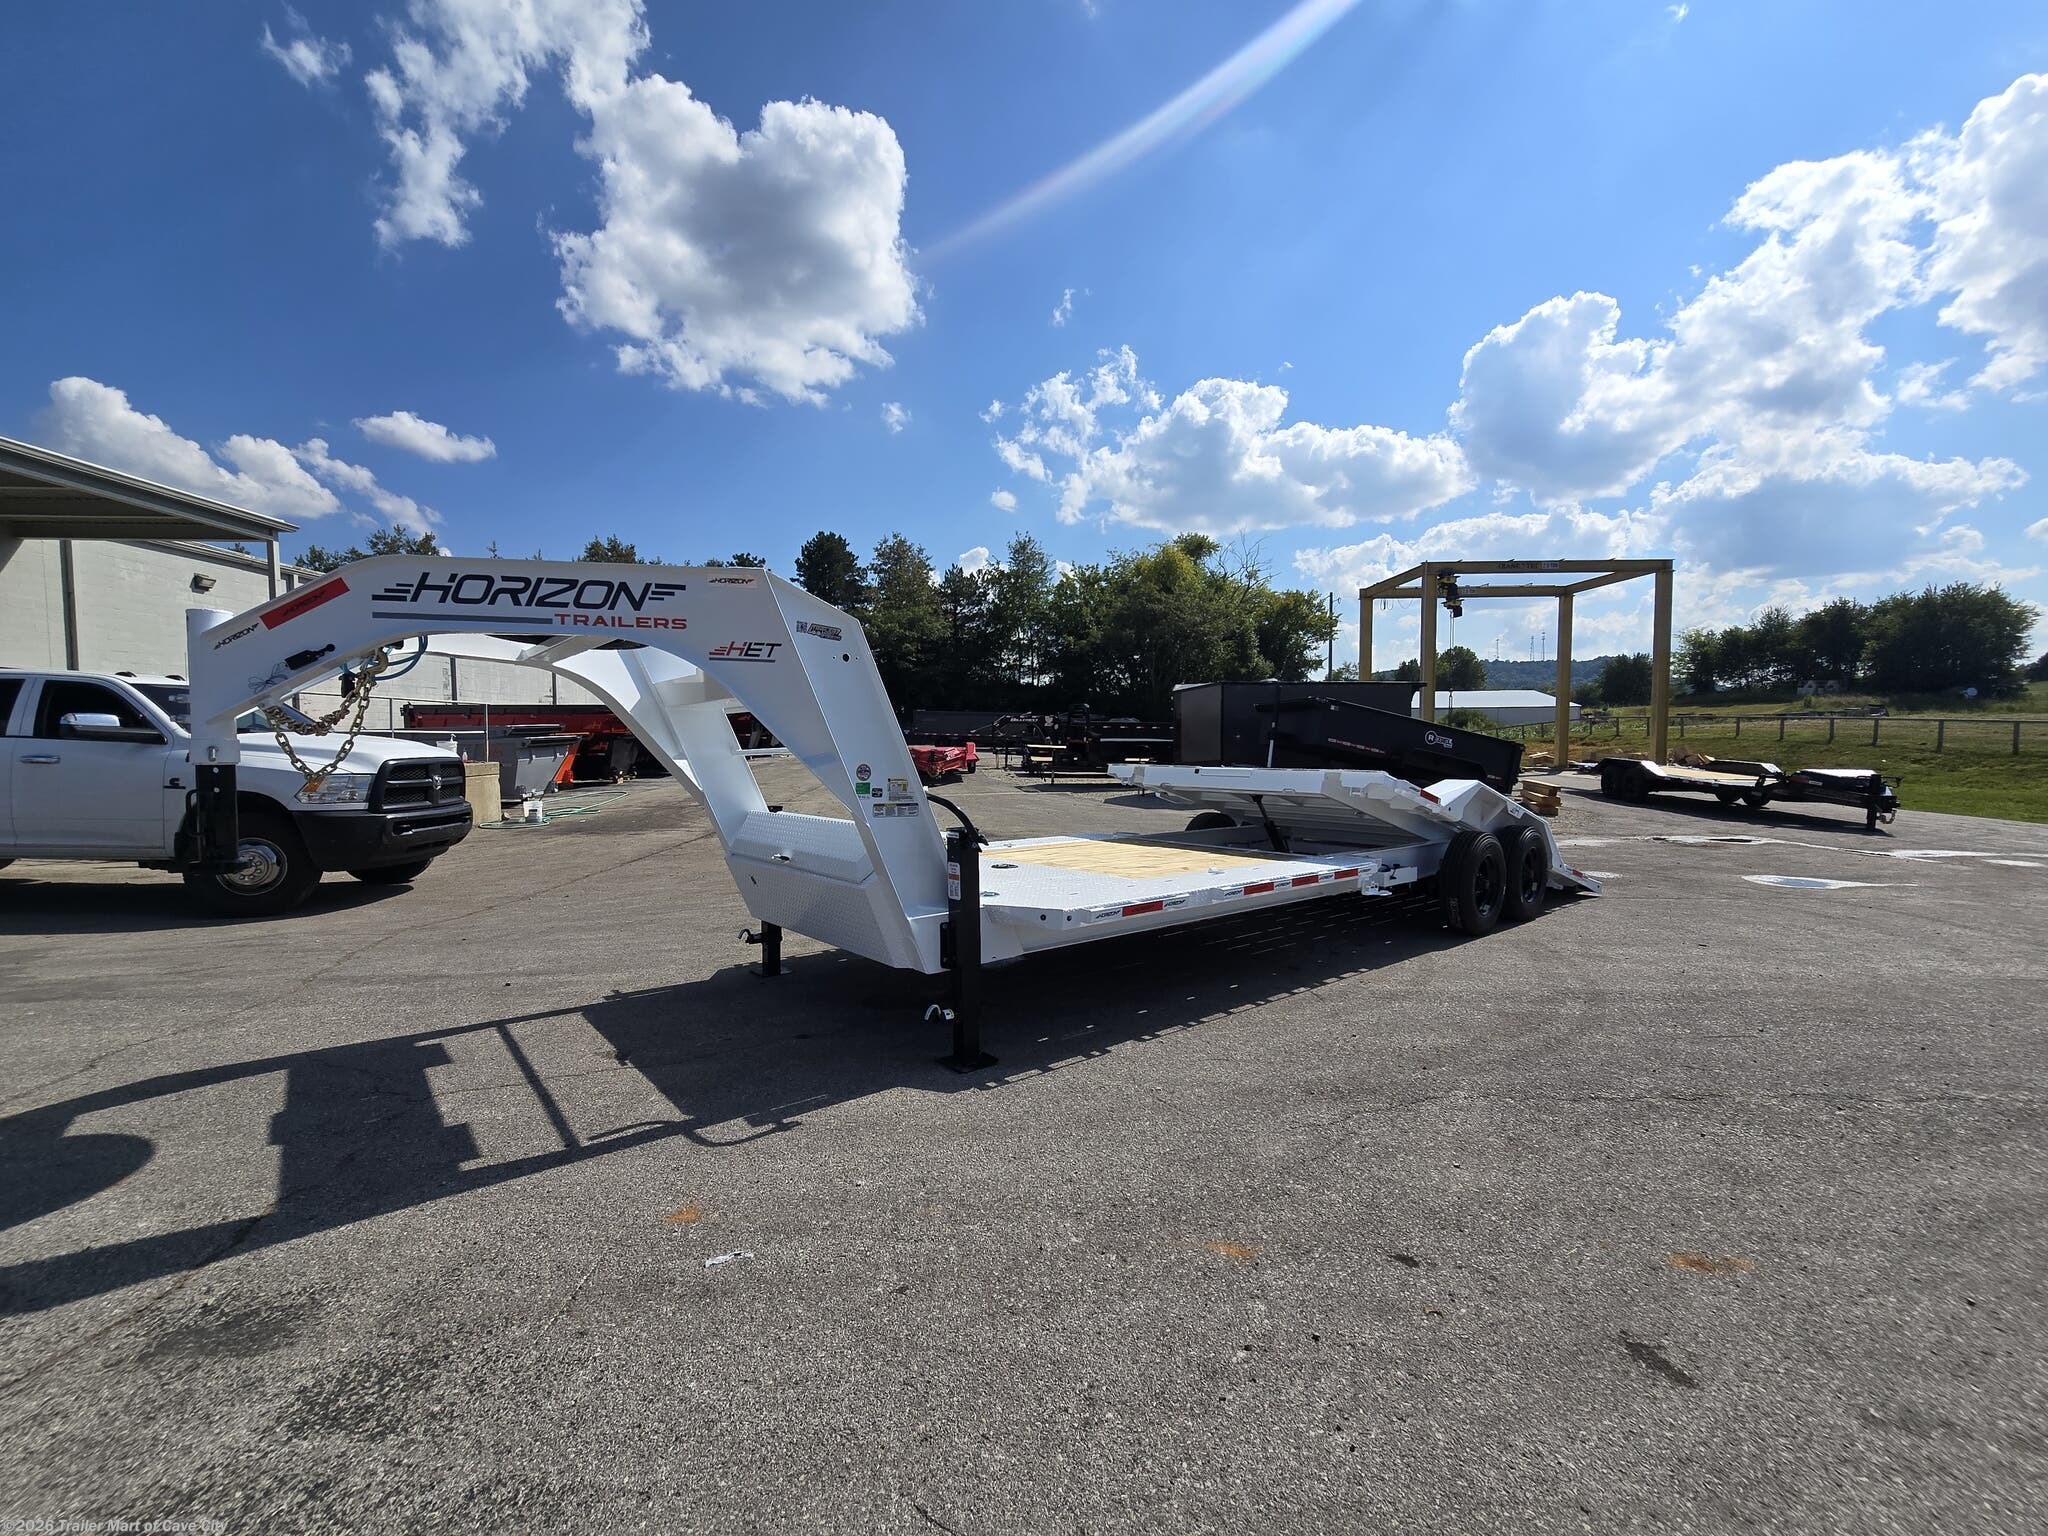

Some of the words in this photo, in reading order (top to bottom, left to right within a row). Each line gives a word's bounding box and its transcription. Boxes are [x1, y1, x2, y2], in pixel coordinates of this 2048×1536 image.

[711, 577, 752, 585] HORIZON
[408, 572, 652, 611] HORIZON
[554, 613, 687, 630] TRAILERS
[213, 622, 259, 650] HORIZON
[725, 641, 782, 658] HET
